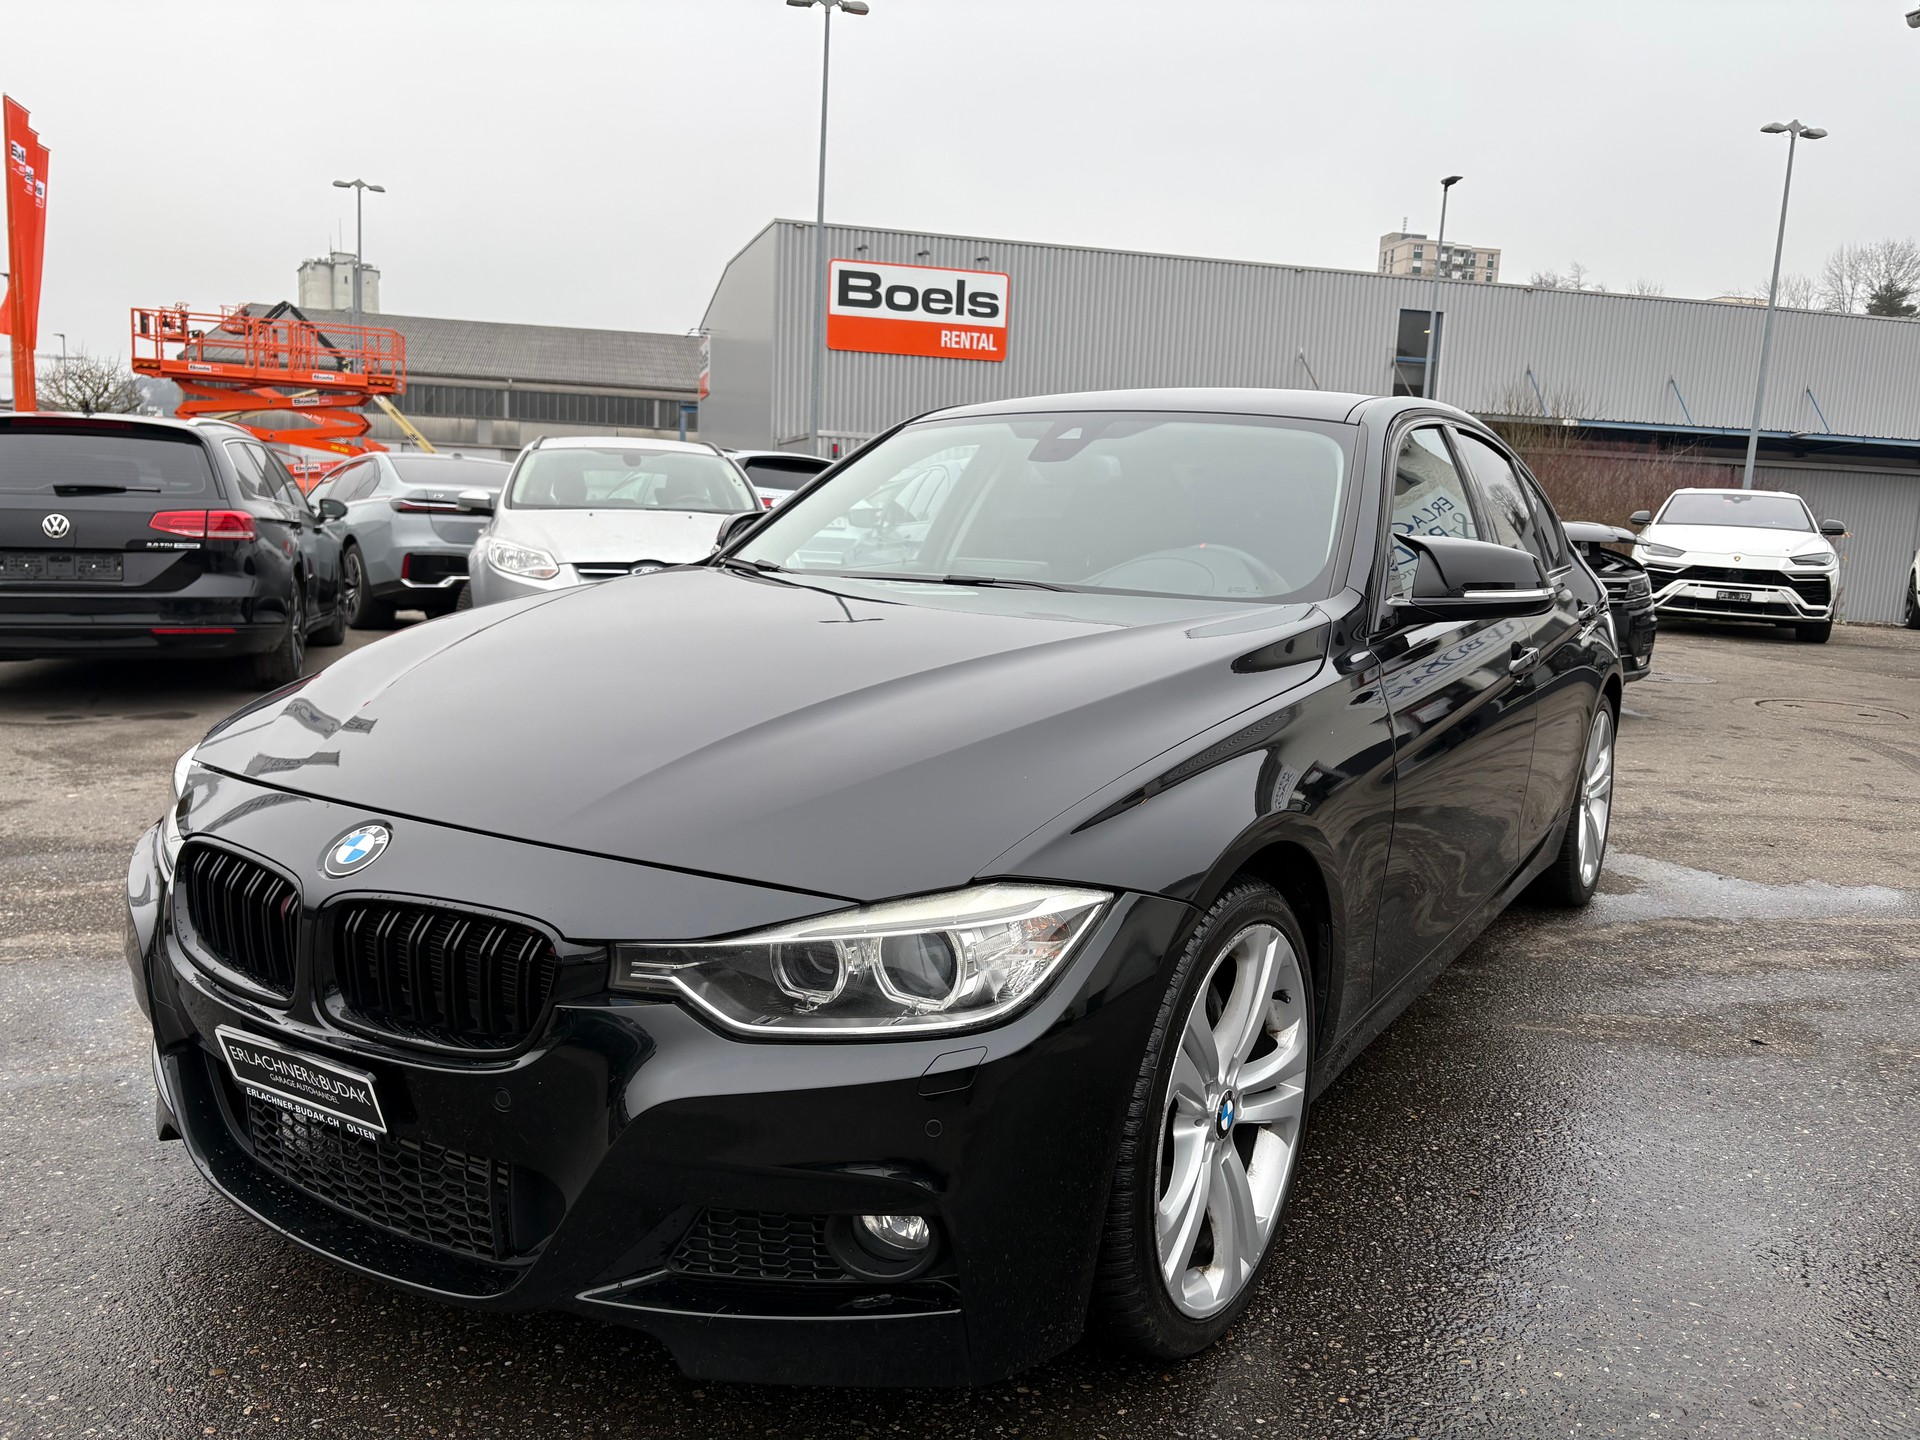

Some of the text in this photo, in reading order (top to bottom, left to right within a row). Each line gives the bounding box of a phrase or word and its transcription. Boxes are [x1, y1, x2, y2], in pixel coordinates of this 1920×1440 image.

[838, 269, 999, 318] Boels
[940, 330, 998, 351] RENTAL
[269, 1073, 340, 1105] GARAGE AUTOHANDEL
[246, 1086, 377, 1141] ERLACHNER-BUDAK.CH OLTEN
